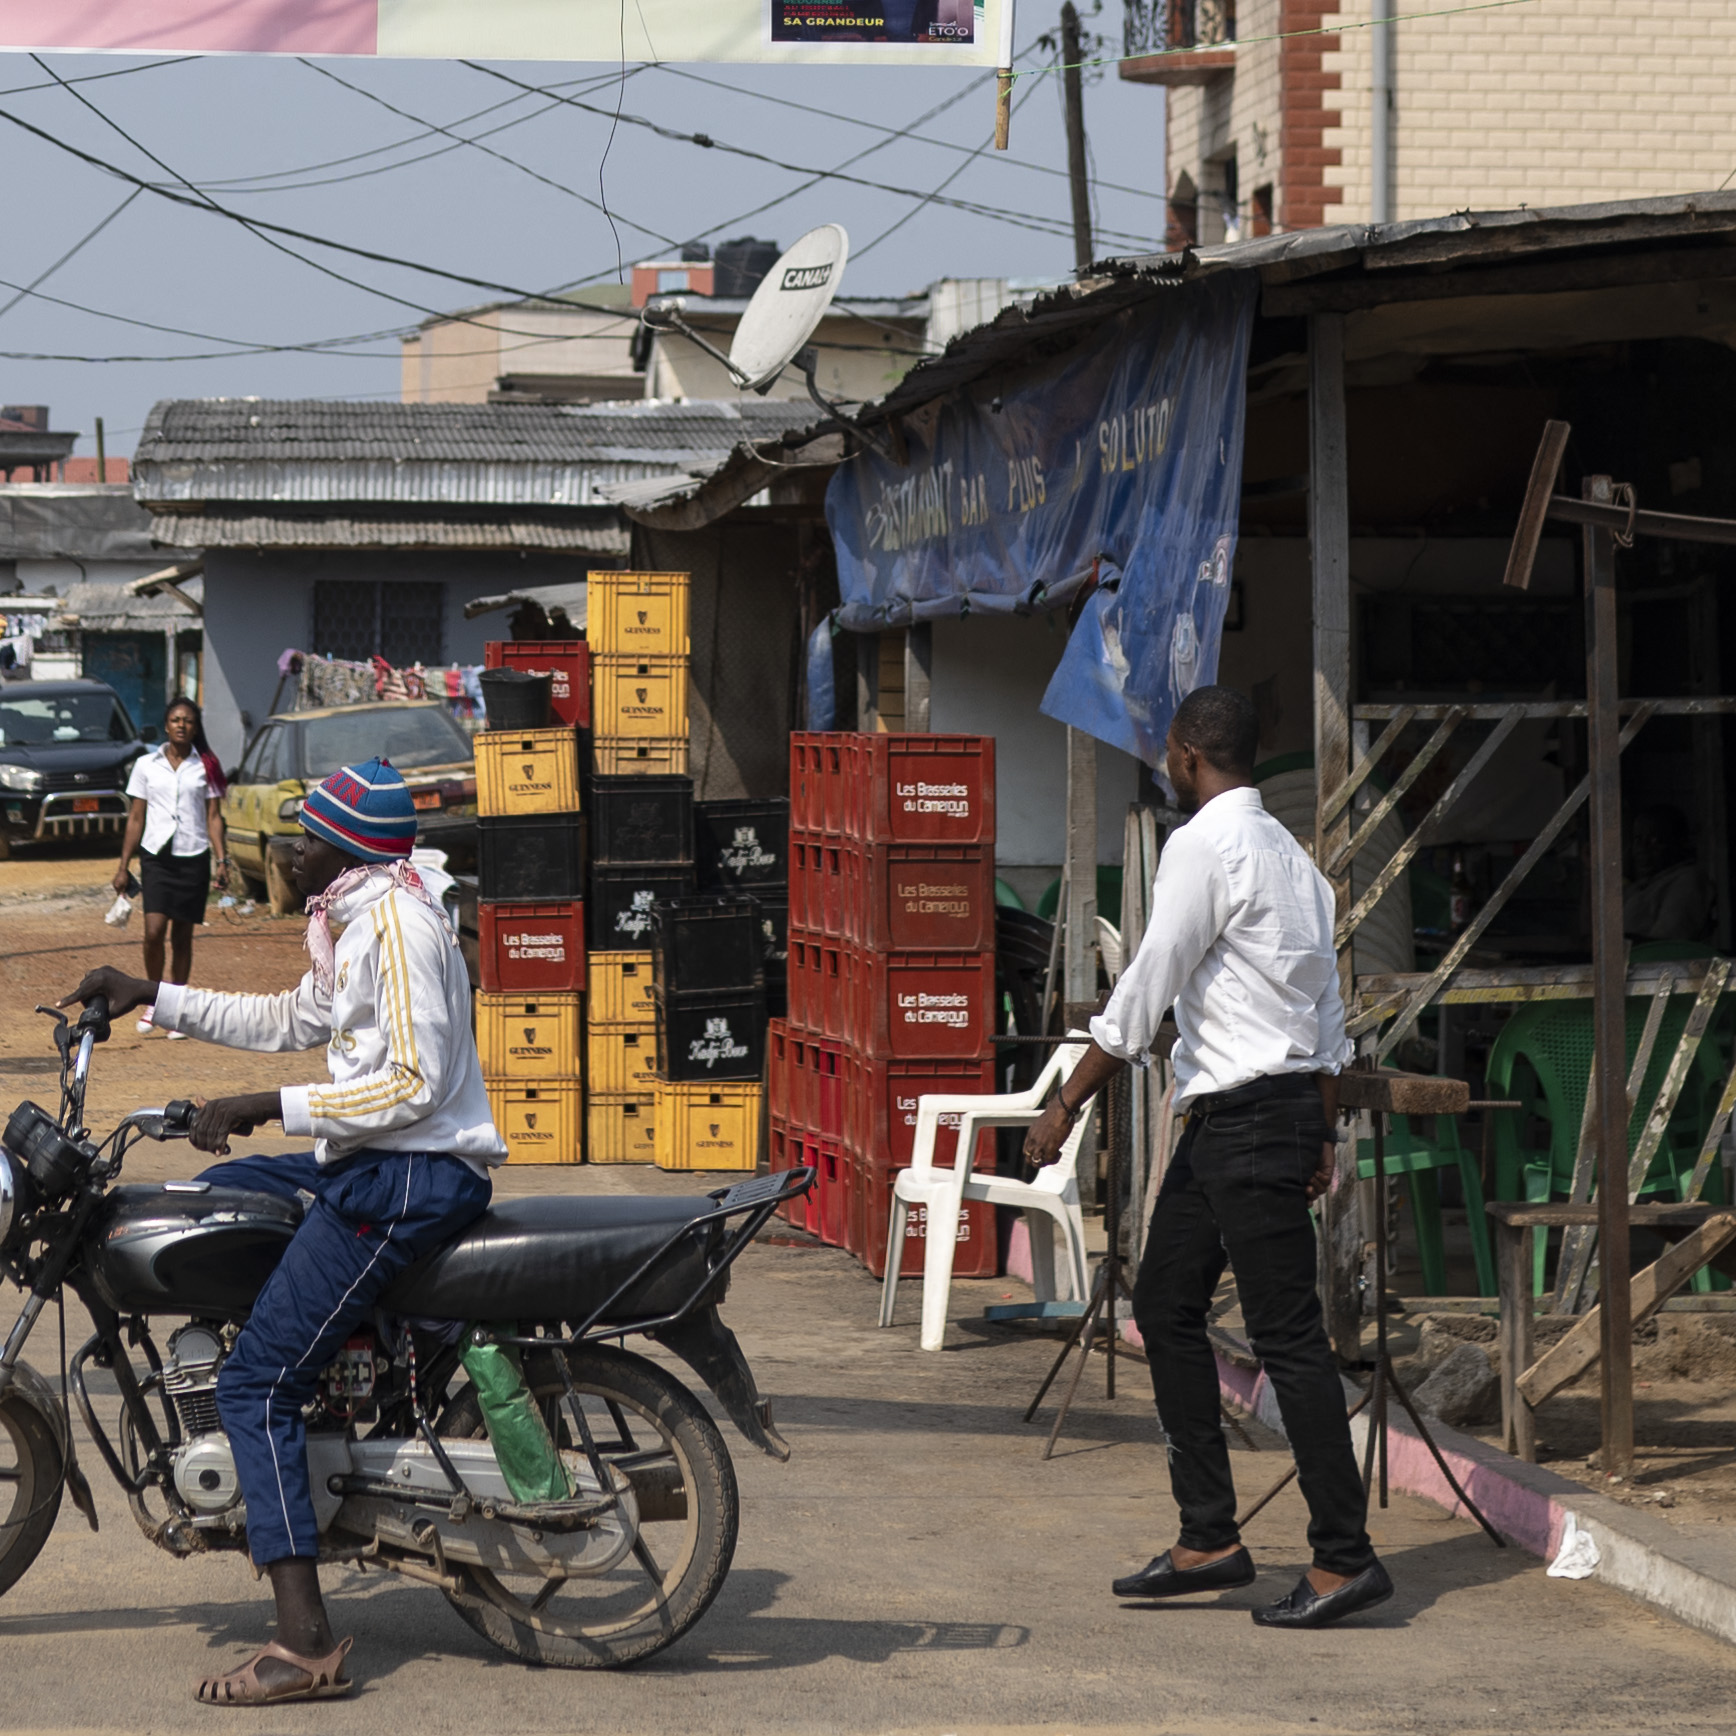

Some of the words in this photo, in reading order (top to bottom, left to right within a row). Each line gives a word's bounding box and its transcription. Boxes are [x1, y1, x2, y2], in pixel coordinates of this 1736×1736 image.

[784, 17, 802, 25] SA
[806, 17, 884, 26] GRANDEUR
[928, 27, 969, 36] ETO'O
[1008, 454, 1046, 512] PLUS
[624, 626, 660, 634] GUINNESS
[621, 705, 664, 714] GUINNESS
[509, 782, 552, 791] GUINNESS
[896, 782, 915, 796] Les
[917, 782, 968, 796] Brasseries
[903, 800, 916, 812] du
[917, 799, 969, 812] Cameroun
[897, 883, 917, 897] Les
[918, 883, 968, 896] Brasseries
[905, 901, 917, 912] du
[918, 901, 969, 913] Cameroun
[502, 933, 520, 945] Les
[520, 947, 565, 958] Cameroun
[897, 993, 916, 1007] Les
[918, 992, 968, 1007] Brasseries
[904, 1010, 917, 1022] du
[917, 1010, 969, 1023] Cameroun
[509, 1046, 553, 1055] GUINNESS
[896, 1095, 916, 1110] Les
[509, 1131, 554, 1140] GUINNESS
